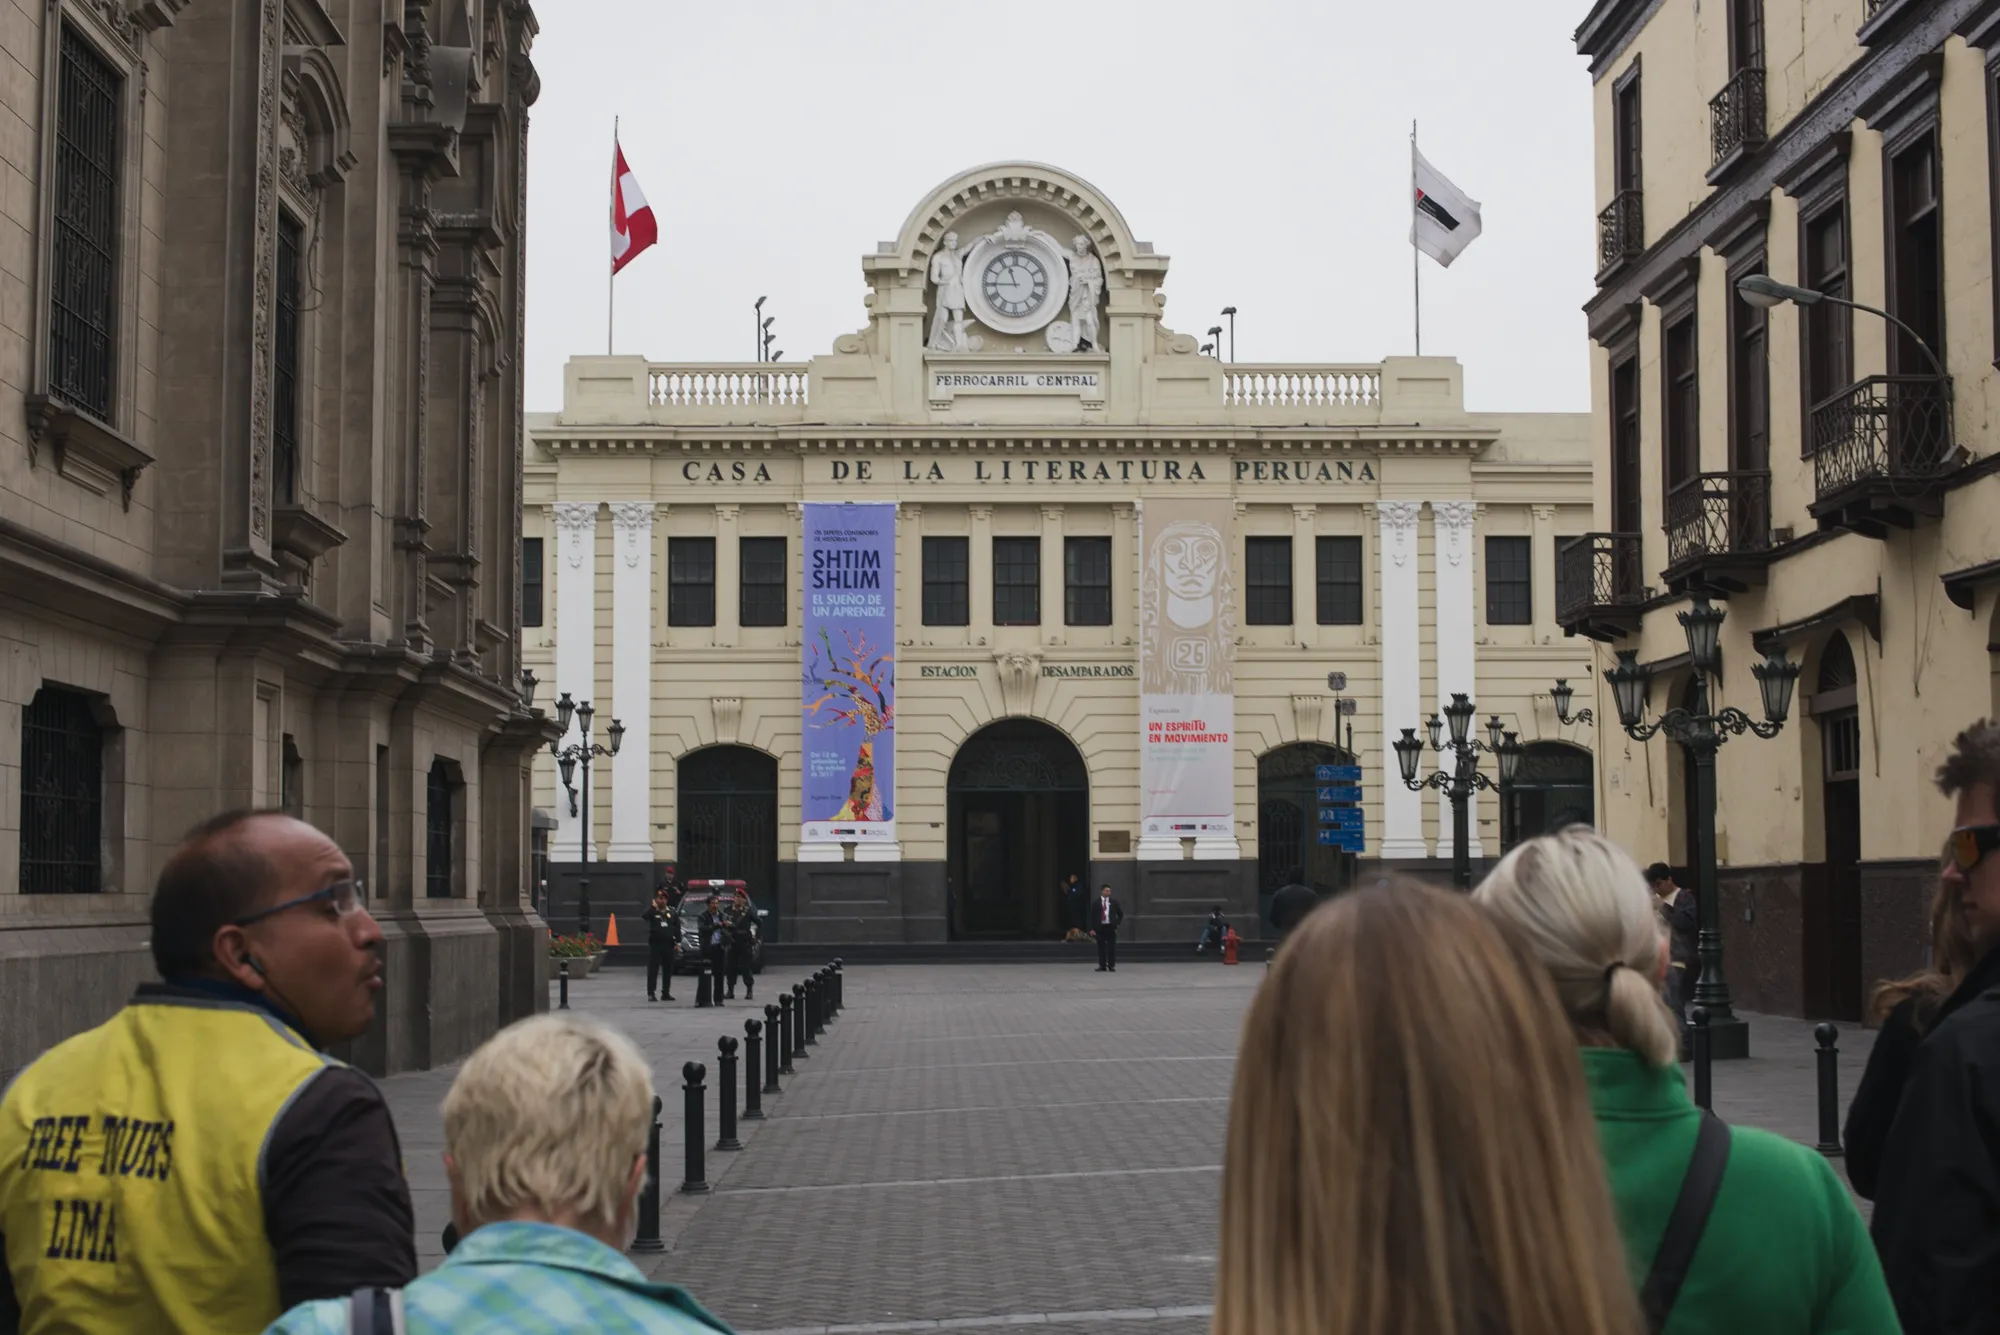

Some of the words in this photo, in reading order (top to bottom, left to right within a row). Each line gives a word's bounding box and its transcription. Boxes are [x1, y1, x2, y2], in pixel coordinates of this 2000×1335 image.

[936, 375, 1029, 386] FERROCARRIL
[1036, 375, 1097, 386] CENTRAL
[682, 461, 772, 481] CASA
[831, 460, 873, 481] DE
[903, 460, 945, 481] LA
[974, 460, 1206, 481] LITERATURA
[1233, 460, 1376, 481] PERUANA
[812, 549, 881, 569] SHTIM
[812, 570, 880, 589] SHLIM
[812, 594, 824, 605] EL
[826, 592, 865, 605] SUEÑO
[867, 594, 882, 605] DE
[812, 606, 830, 617] UN
[832, 606, 886, 617] APRENDIZ
[921, 666, 977, 677] ESTACION
[1042, 665, 1134, 677] DESAMPARADOS
[1148, 722, 1162, 731] UN
[1148, 734, 1162, 743] EN
[1164, 733, 1229, 743] MOVIMIENTO
[21, 1115, 91, 1173] FREE
[46, 1200, 118, 1263] LIMA
